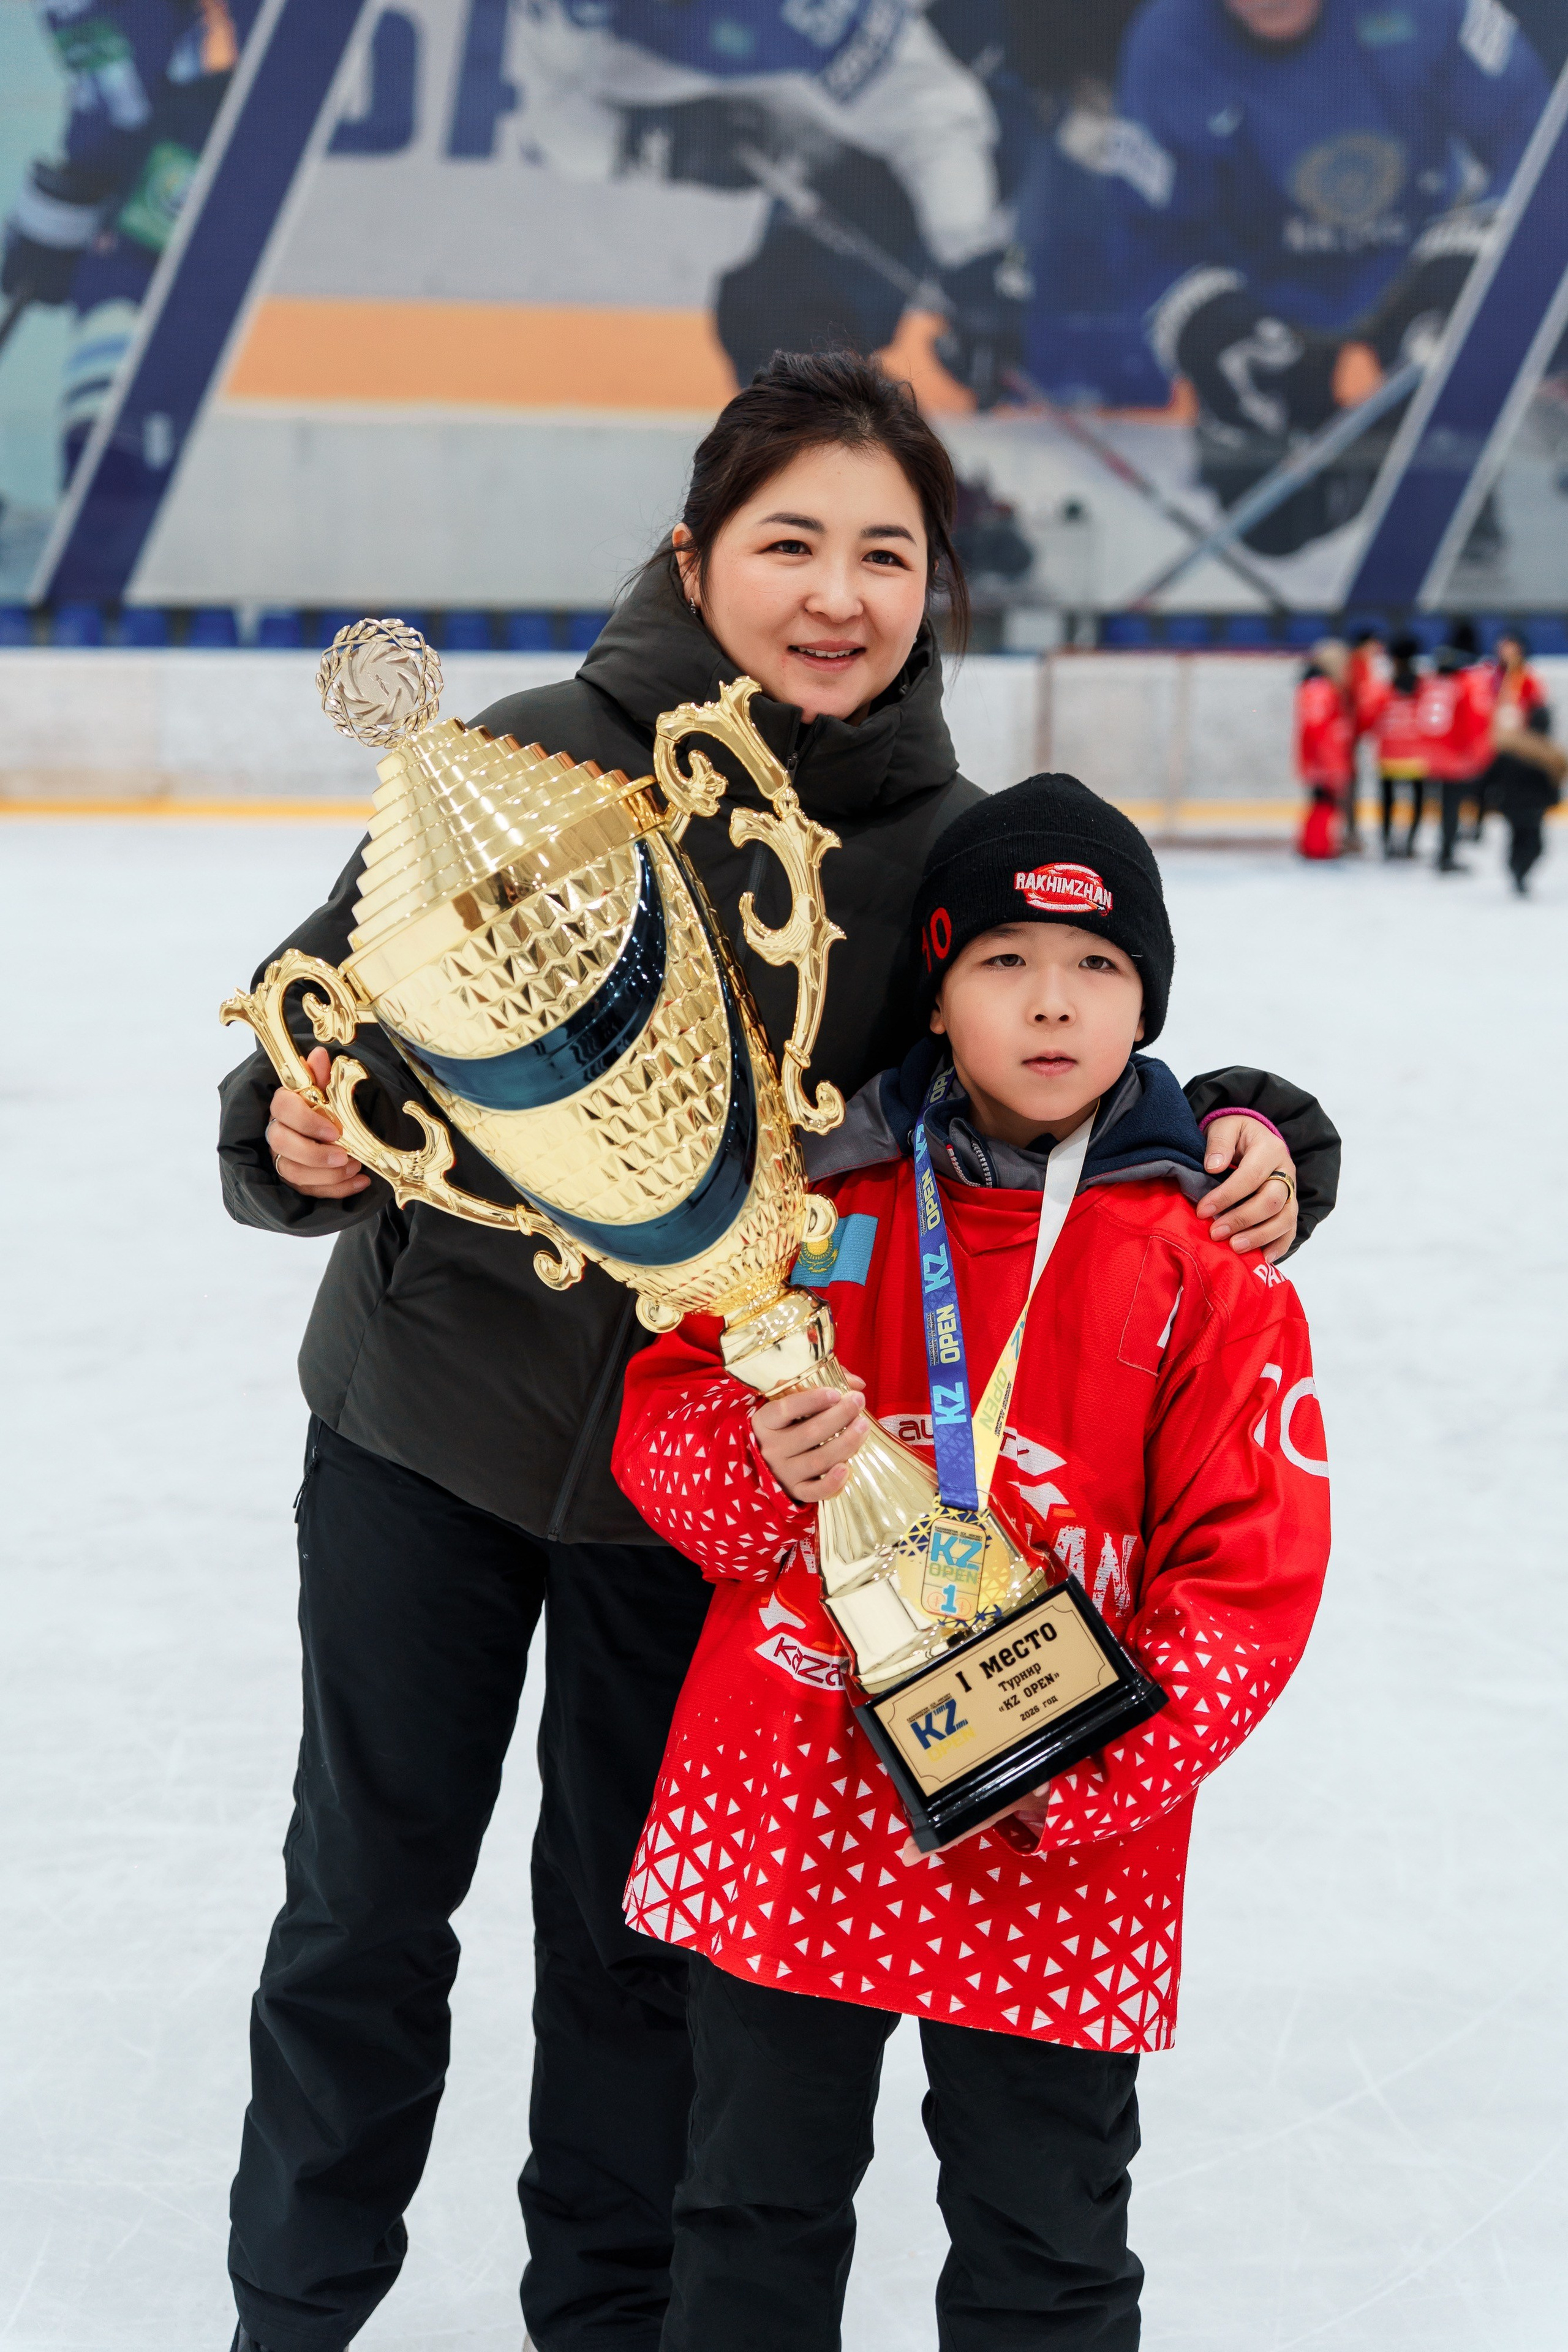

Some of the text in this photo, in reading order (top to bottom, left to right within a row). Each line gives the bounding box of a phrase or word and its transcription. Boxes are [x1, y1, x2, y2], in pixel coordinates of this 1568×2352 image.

[1016, 872, 1112, 909] RAKHIMZHAN
[922, 907, 952, 973] 10
[921, 1167, 951, 1294] KZ OPEN
[932, 1303, 967, 1425] KZ OPEN
[979, 1367, 1008, 1431] OPEN
[930, 1532, 982, 1572] KZ
[929, 1562, 978, 1585] OPEN
[941, 1584, 957, 1613] 1
[955, 1670, 972, 1694] I
[997, 1662, 1042, 1692] Турнир
[998, 1672, 1060, 1713] «KZ OPEN»
[910, 1698, 969, 1751] KZ
[1019, 1695, 1058, 1722] 2026 год
[926, 1725, 977, 1763] OPEN
